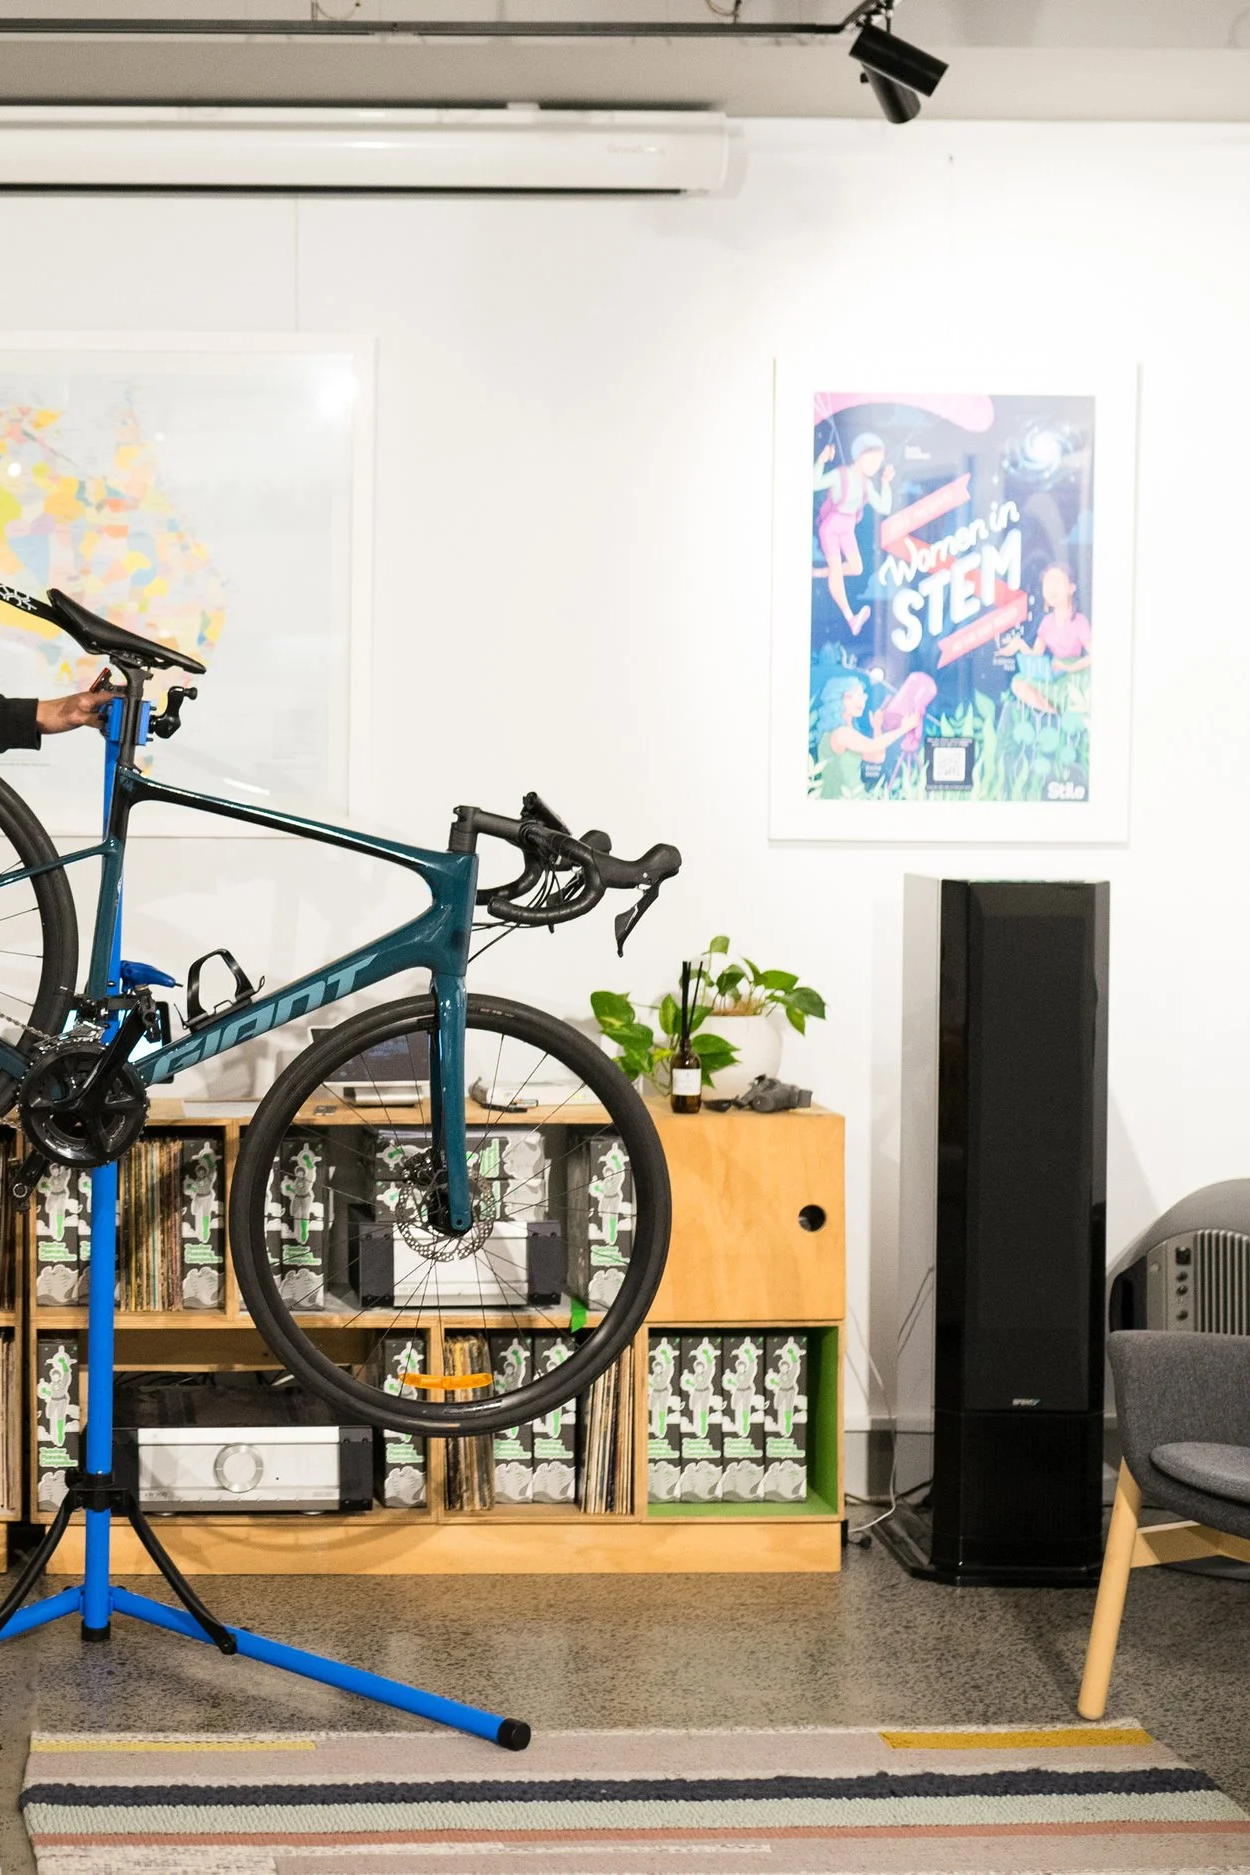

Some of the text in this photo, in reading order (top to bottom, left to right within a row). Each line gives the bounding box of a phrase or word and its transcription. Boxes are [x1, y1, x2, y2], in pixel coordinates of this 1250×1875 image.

[878, 518, 989, 587] Women
[989, 501, 1020, 532] in
[891, 528, 1022, 652] STEM
[1047, 782, 1086, 800] Stile
[151, 953, 379, 1084] GIANT
